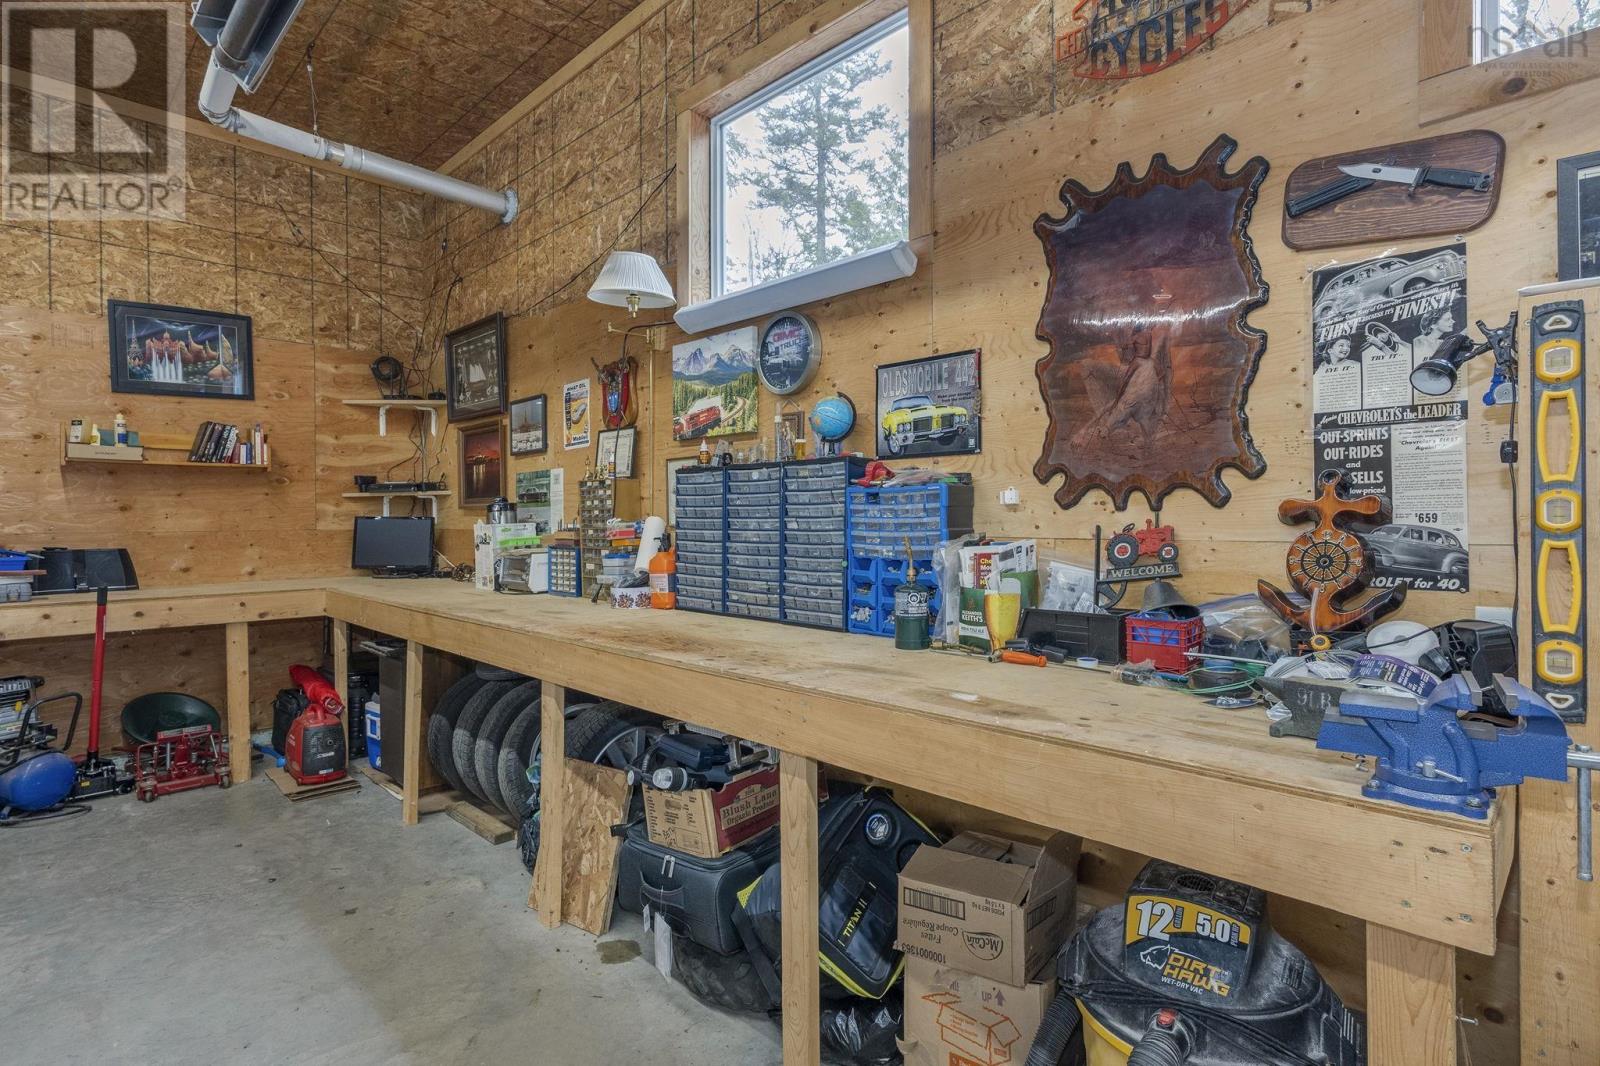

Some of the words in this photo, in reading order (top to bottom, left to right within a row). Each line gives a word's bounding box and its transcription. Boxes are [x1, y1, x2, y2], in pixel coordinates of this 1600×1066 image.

[1318, 319, 1359, 343] FIRST
[882, 363, 949, 397] OLDSMOBILE
[955, 358, 976, 387] 442
[1337, 406, 1402, 426] CHEVROLET'S
[1403, 407, 1417, 419] the
[1417, 403, 1462, 419] LEADER
[1320, 427, 1389, 444] OUT-SPRINTS
[1323, 445, 1384, 461] OUT-RIDES
[1350, 470, 1384, 484] SELLS
[1415, 512, 1438, 524] $659
[1111, 564, 1174, 578] WELCOME
[1414, 577, 1433, 589] for
[962, 614, 984, 623] KEITH'S
[843, 905, 863, 938] TITAN
[934, 924, 959, 936] Coupe
[1136, 900, 1175, 942] 12
[1196, 912, 1231, 943] 5.0
[967, 935, 1001, 952] McCain
[1168, 952, 1224, 978] DIRT
[1161, 975, 1190, 990] WET-DRY
[1189, 985, 1204, 995] VAC
[1163, 964, 1230, 997] HAWG
